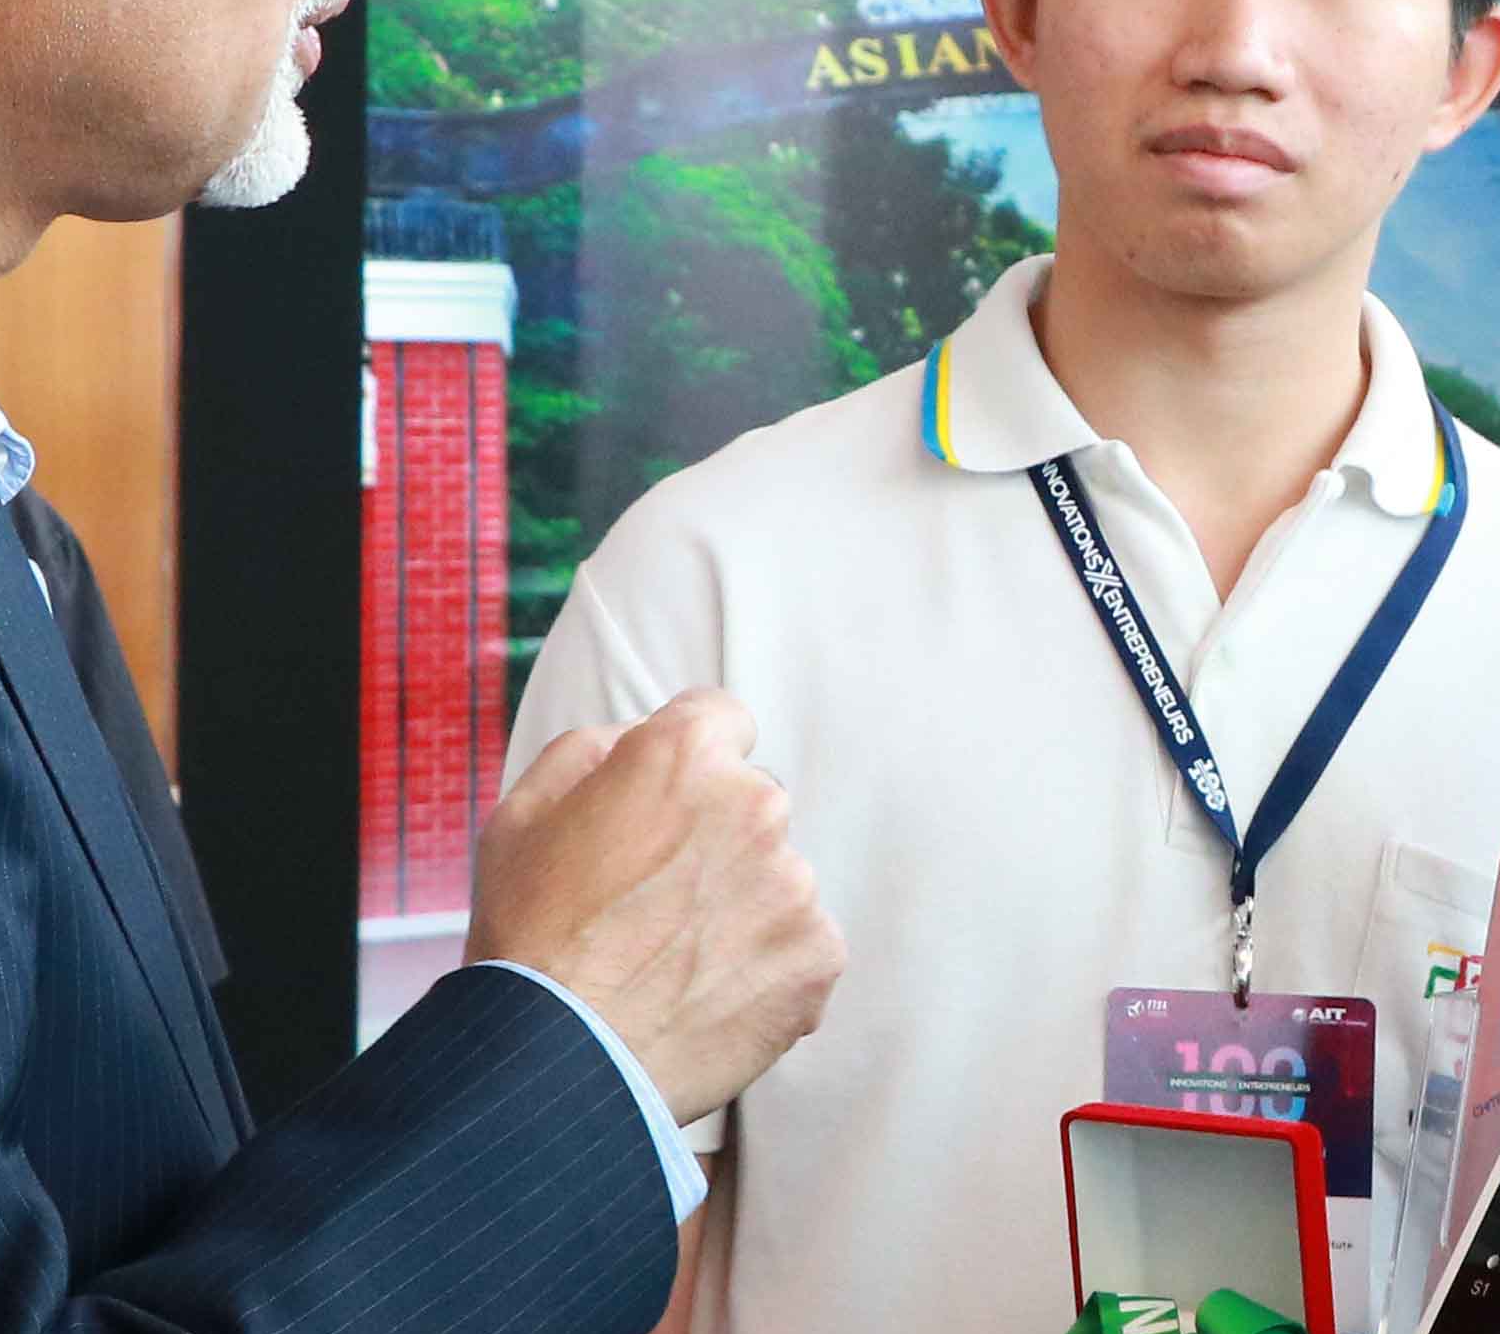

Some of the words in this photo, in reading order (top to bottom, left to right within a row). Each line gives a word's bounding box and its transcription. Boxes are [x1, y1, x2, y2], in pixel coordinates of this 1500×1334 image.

[1102, 587, 1194, 746] ENTREPRENEURS
[1309, 1007, 1348, 1021] AIT
[1469, 1278, 1491, 1298] S1
